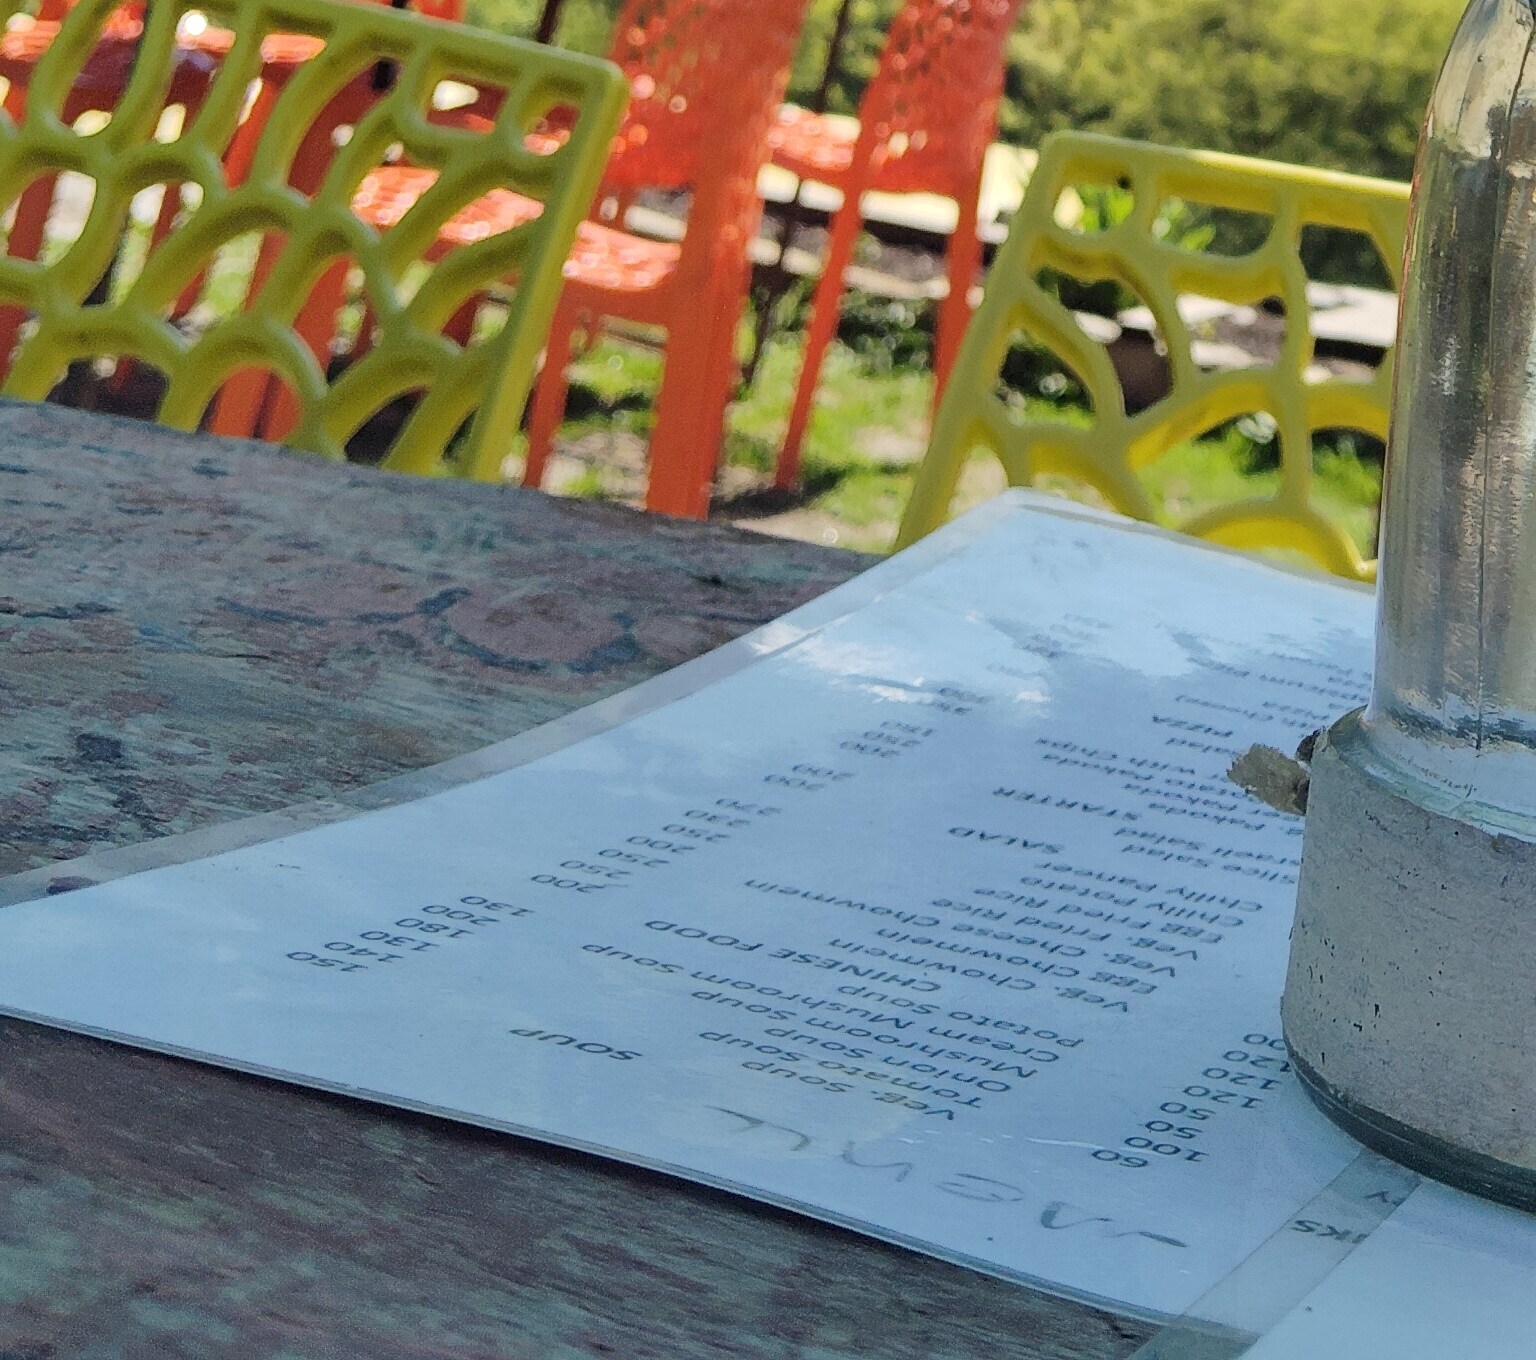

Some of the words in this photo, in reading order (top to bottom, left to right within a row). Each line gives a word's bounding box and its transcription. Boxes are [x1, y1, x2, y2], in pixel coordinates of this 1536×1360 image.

[991, 786, 1140, 822] STARTER
[624, 834, 697, 855] 200
[947, 827, 1065, 855] SALAD
[559, 859, 631, 880] 250
[598, 848, 670, 869] 250
[530, 874, 606, 894] 200
[1034, 862, 1158, 893] Paneer
[743, 879, 941, 927] Chowmein
[973, 888, 1049, 909] Rice
[1020, 877, 1138, 907] Potato
[1165, 886, 1264, 913] Chilly
[421, 905, 500, 927] 200
[460, 895, 535, 918] 130
[931, 898, 1008, 922] Rice
[1054, 903, 1152, 930] Fried
[1144, 901, 1244, 928] Chilly
[359, 930, 440, 953] 130
[394, 918, 475, 939] 180
[644, 920, 764, 952] FOOD
[951, 924, 1086, 957] Cheese
[1013, 915, 1111, 943] Fried
[1159, 922, 1223, 944] Egg
[285, 951, 368, 973] 150
[324, 941, 404, 964] 140
[581, 944, 684, 974] Soup
[875, 928, 1080, 979] Chowmein
[1125, 936, 1198, 962] Veg.
[767, 947, 942, 993] CHINESE
[828, 939, 1036, 991] Chowmein
[1102, 953, 1176, 978] Veg.
[1088, 972, 1158, 995] Egg
[689, 971, 916, 1030] Mushroom
[691, 991, 797, 1021] Soup
[837, 985, 942, 1015] Soup
[1053, 985, 1128, 1013] Veg.
[764, 1028, 872, 1059] Soup
[948, 1011, 1084, 1048] Potato
[508, 1029, 643, 1061] SOUP
[698, 1031, 809, 1062] Soup
[805, 1017, 1038, 1079] Mushroom
[926, 1026, 1061, 1063] Cream
[741, 1061, 856, 1093] Soup
[817, 1059, 983, 1109] Tomato
[881, 1056, 1012, 1093] Onion
[1202, 1067, 1281, 1090] 120
[870, 1090, 955, 1120] Veg.
[1159, 1101, 1216, 1121] 50
[1182, 1085, 1264, 1110] 120
[1144, 1119, 1203, 1140] 50
[1090, 1148, 1149, 1169] 60
[1123, 1136, 1209, 1162] 100
